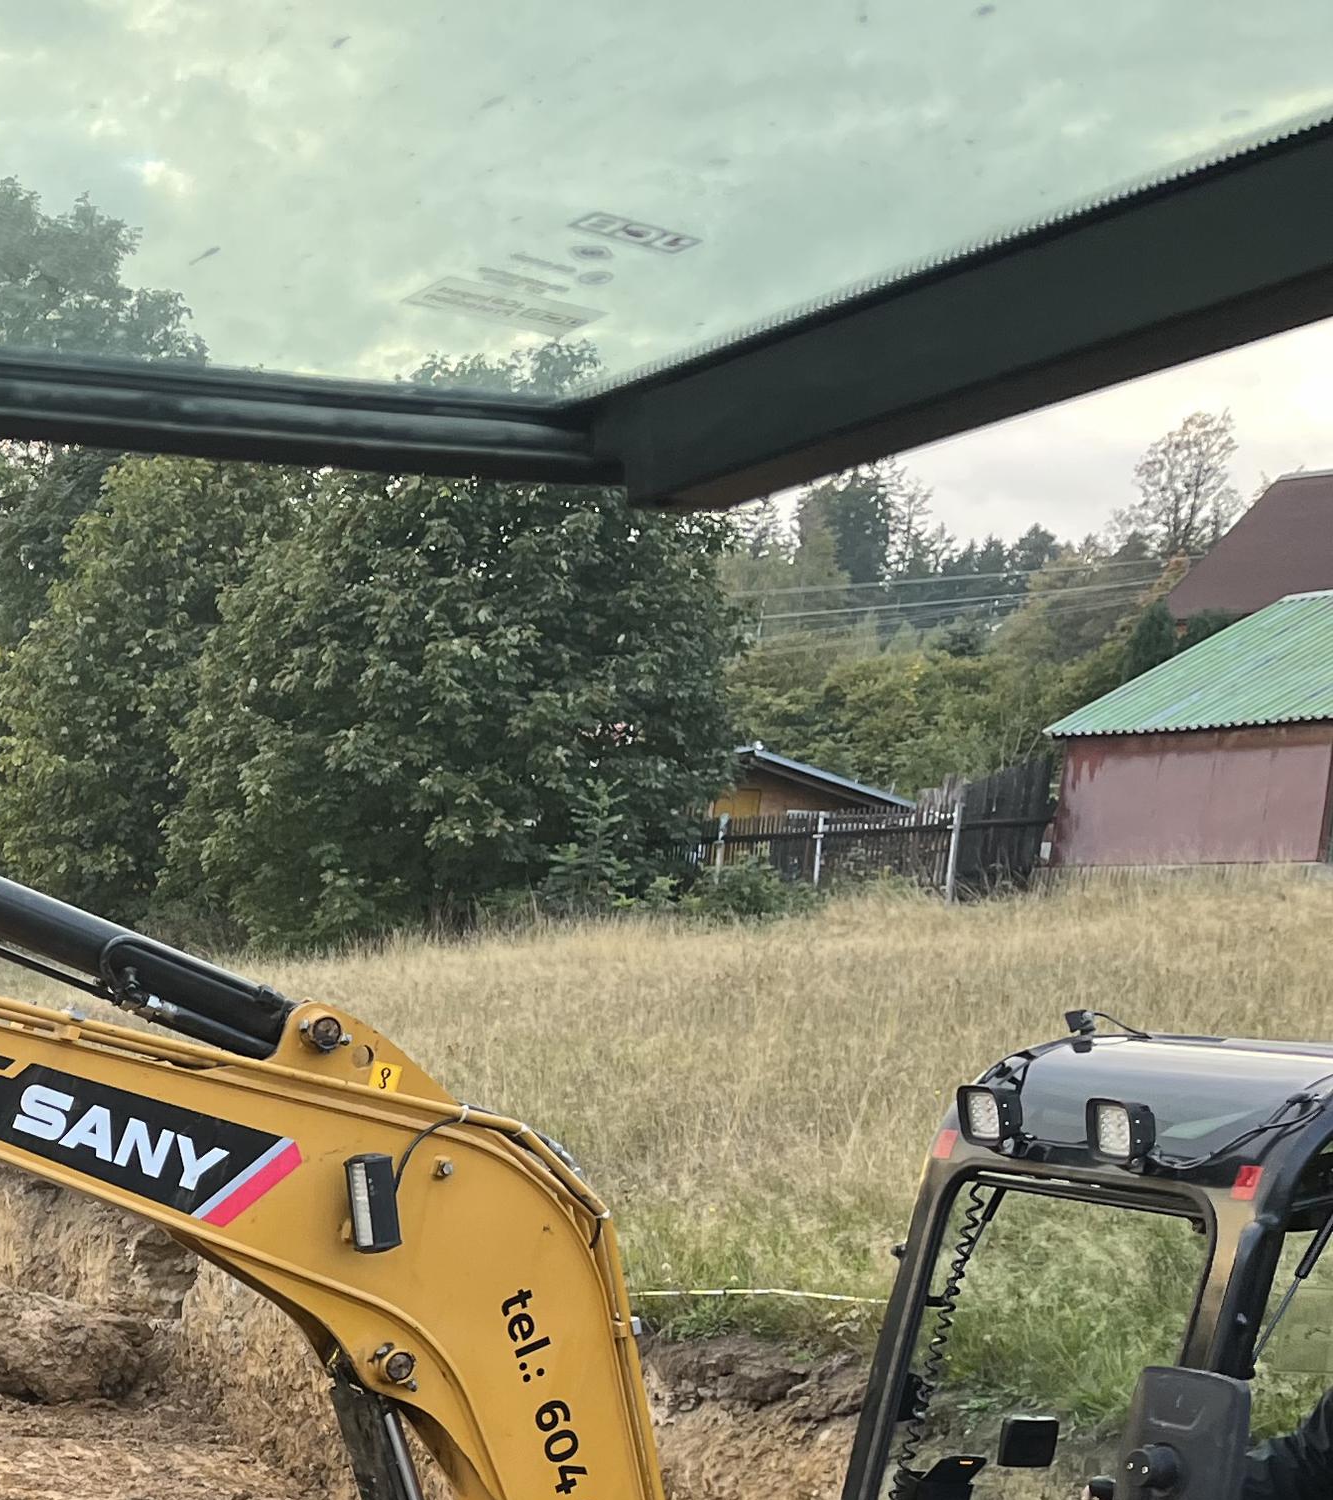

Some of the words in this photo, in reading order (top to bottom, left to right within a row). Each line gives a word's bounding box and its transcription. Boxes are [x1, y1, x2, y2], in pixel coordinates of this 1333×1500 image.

[12, 1084, 230, 1191] SANY
[501, 1288, 551, 1383] tel.:
[535, 1399, 589, 1496] 604
